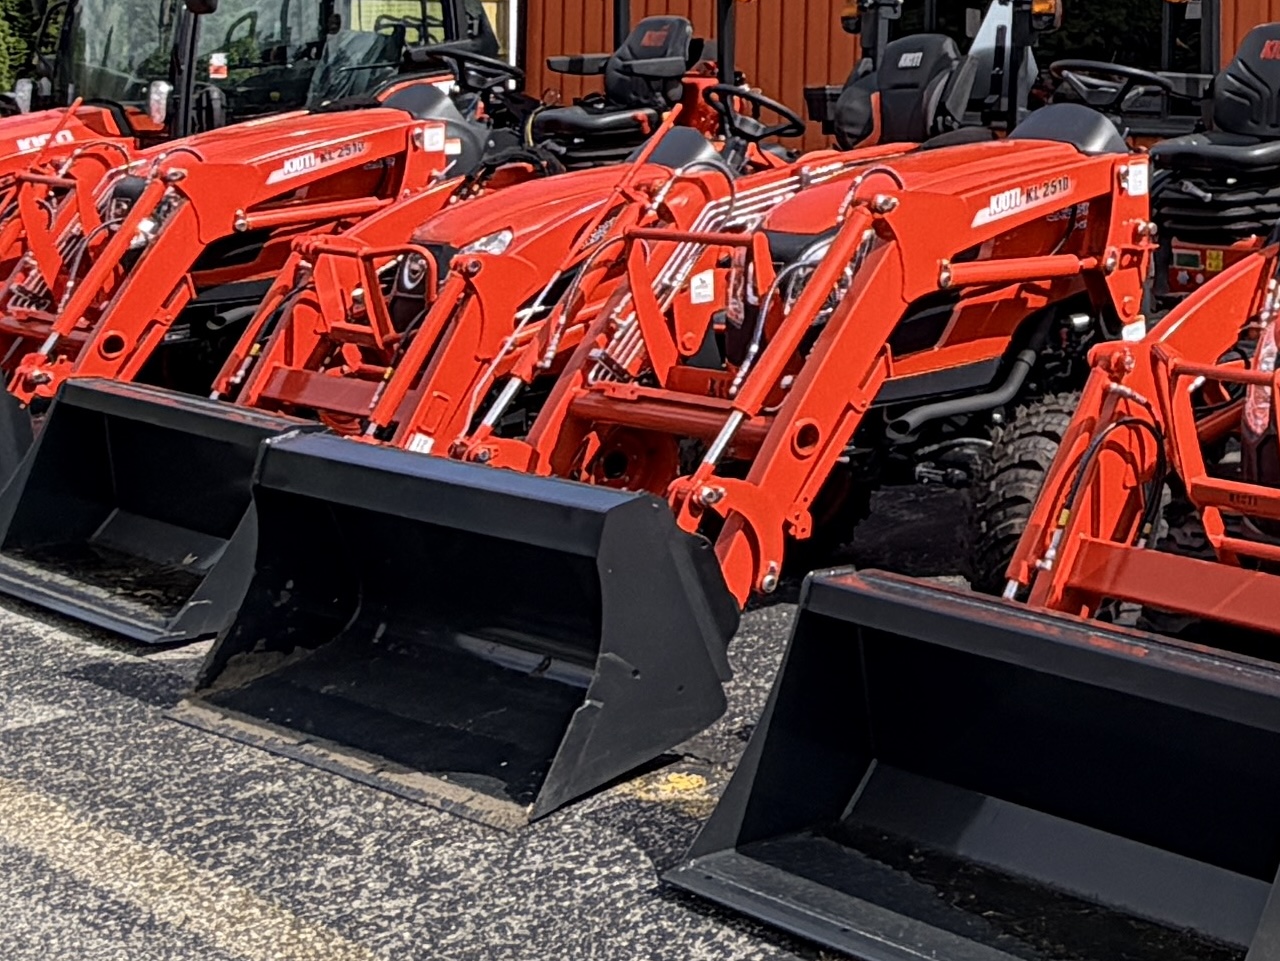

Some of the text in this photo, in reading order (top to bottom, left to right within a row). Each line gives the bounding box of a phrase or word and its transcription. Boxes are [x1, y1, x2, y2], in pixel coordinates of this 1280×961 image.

[988, 187, 1022, 216] KIOTI
[1026, 187, 1039, 204] KL
[1042, 176, 1069, 198] 2510
